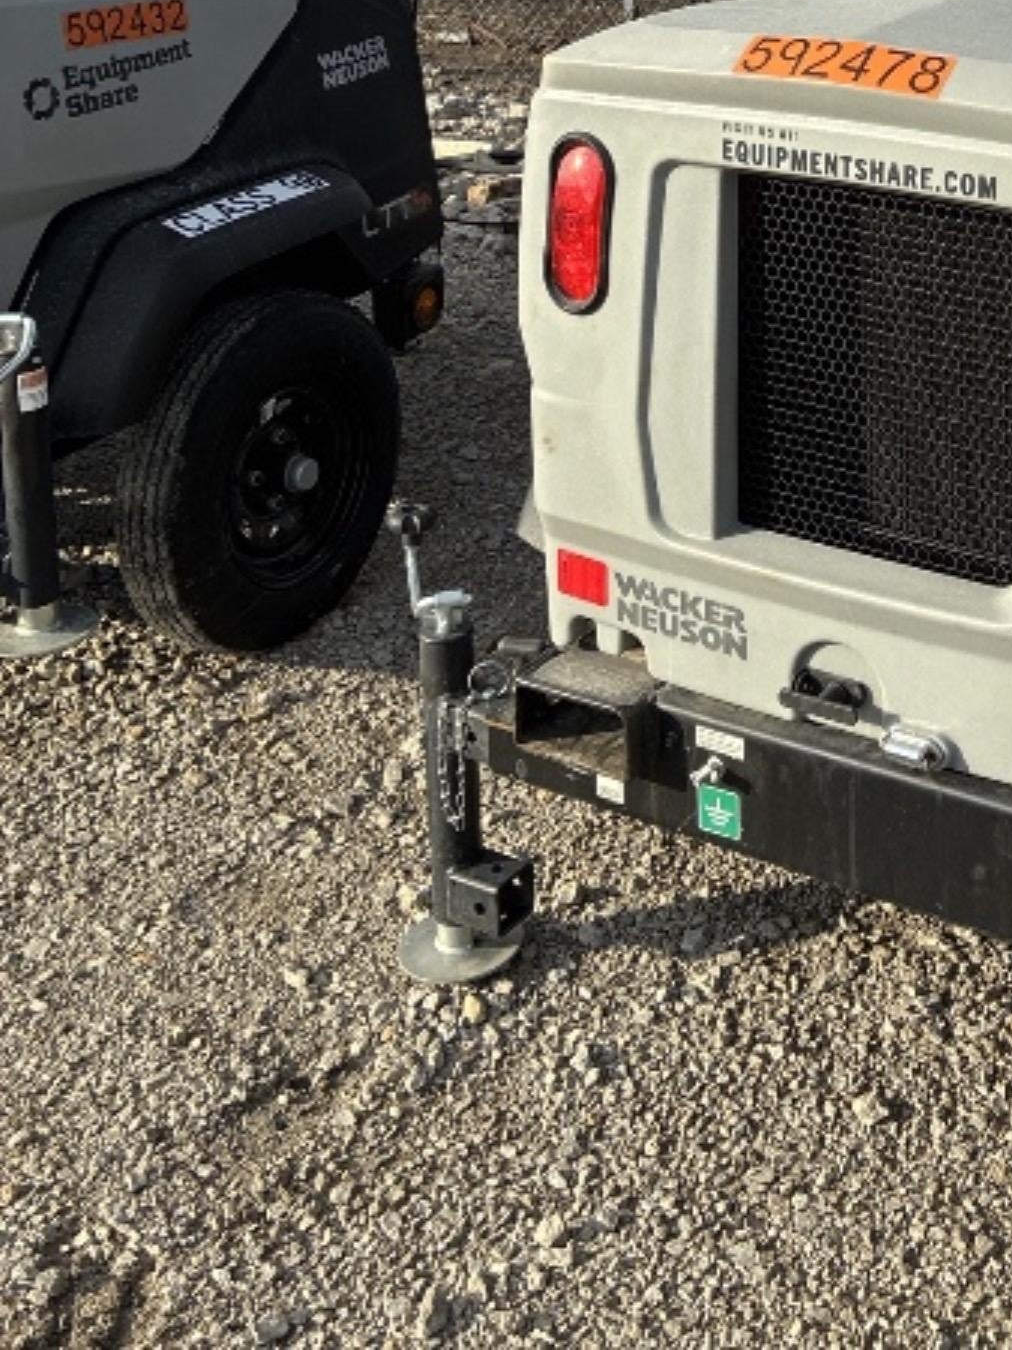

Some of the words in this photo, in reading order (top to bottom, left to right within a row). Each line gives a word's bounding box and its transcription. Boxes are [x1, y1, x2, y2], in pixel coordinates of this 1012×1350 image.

[67, 0, 187, 47] 592432
[61, 38, 193, 90] Equipment
[743, 37, 948, 94] 592478
[65, 83, 140, 117] Share
[721, 137, 998, 200] EQUIPMENTSHARE.COM
[167, 191, 277, 233] CLASS
[614, 572, 748, 633] WACKER
[616, 597, 748, 661] NEUSON
